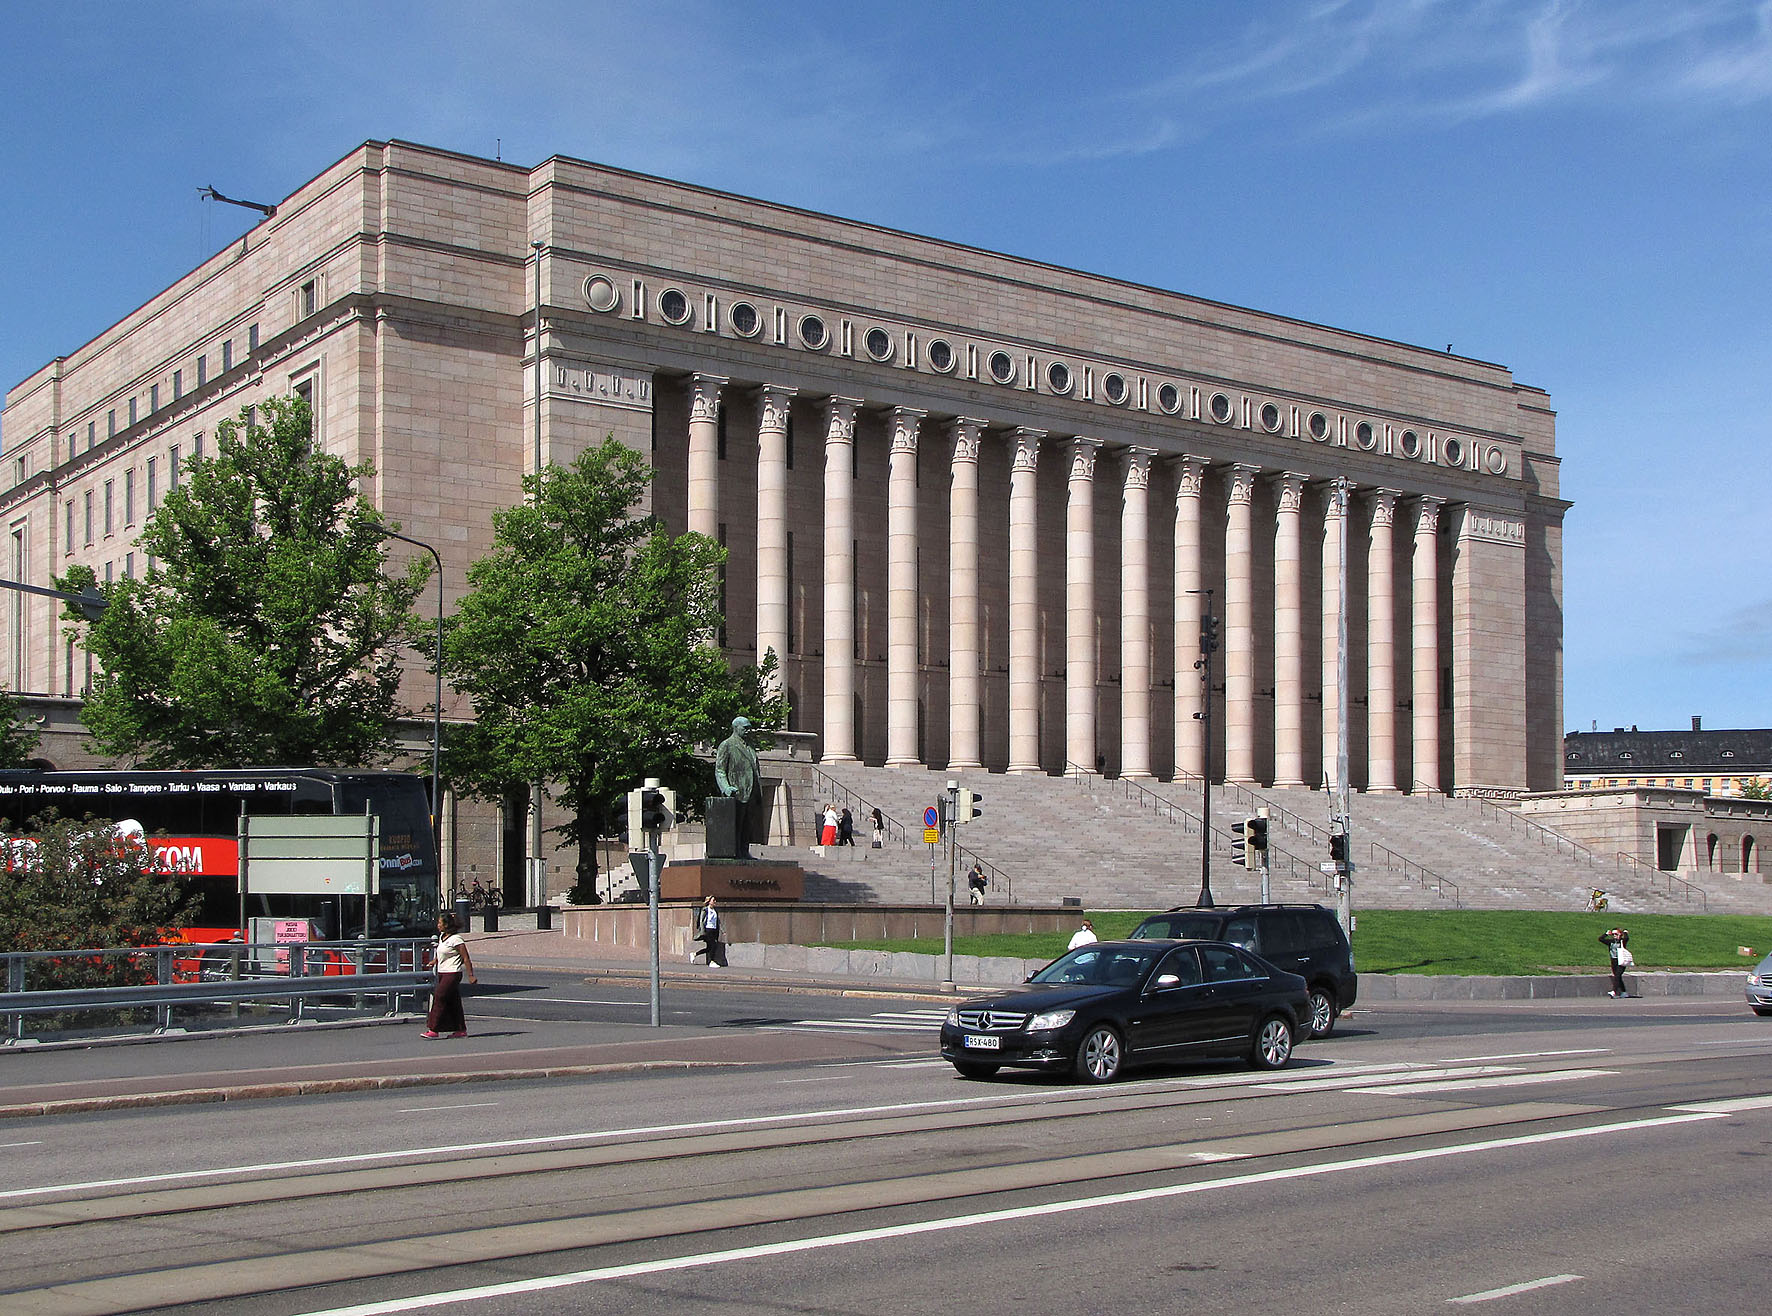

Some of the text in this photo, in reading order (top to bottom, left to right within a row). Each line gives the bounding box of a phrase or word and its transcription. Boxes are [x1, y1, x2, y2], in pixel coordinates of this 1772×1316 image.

[19, 784, 34, 794] Pori
[40, 784, 66, 794] Porvoo
[72, 783, 98, 793] Rauma
[105, 783, 122, 793] Salo
[129, 783, 162, 794] Tampere
[169, 782, 190, 792] Turku
[197, 782, 220, 792] Vaasa
[229, 781, 256, 791] Vantaa
[264, 781, 297, 791] Varkaus
[969, 1037, 998, 1048] RSX-480
